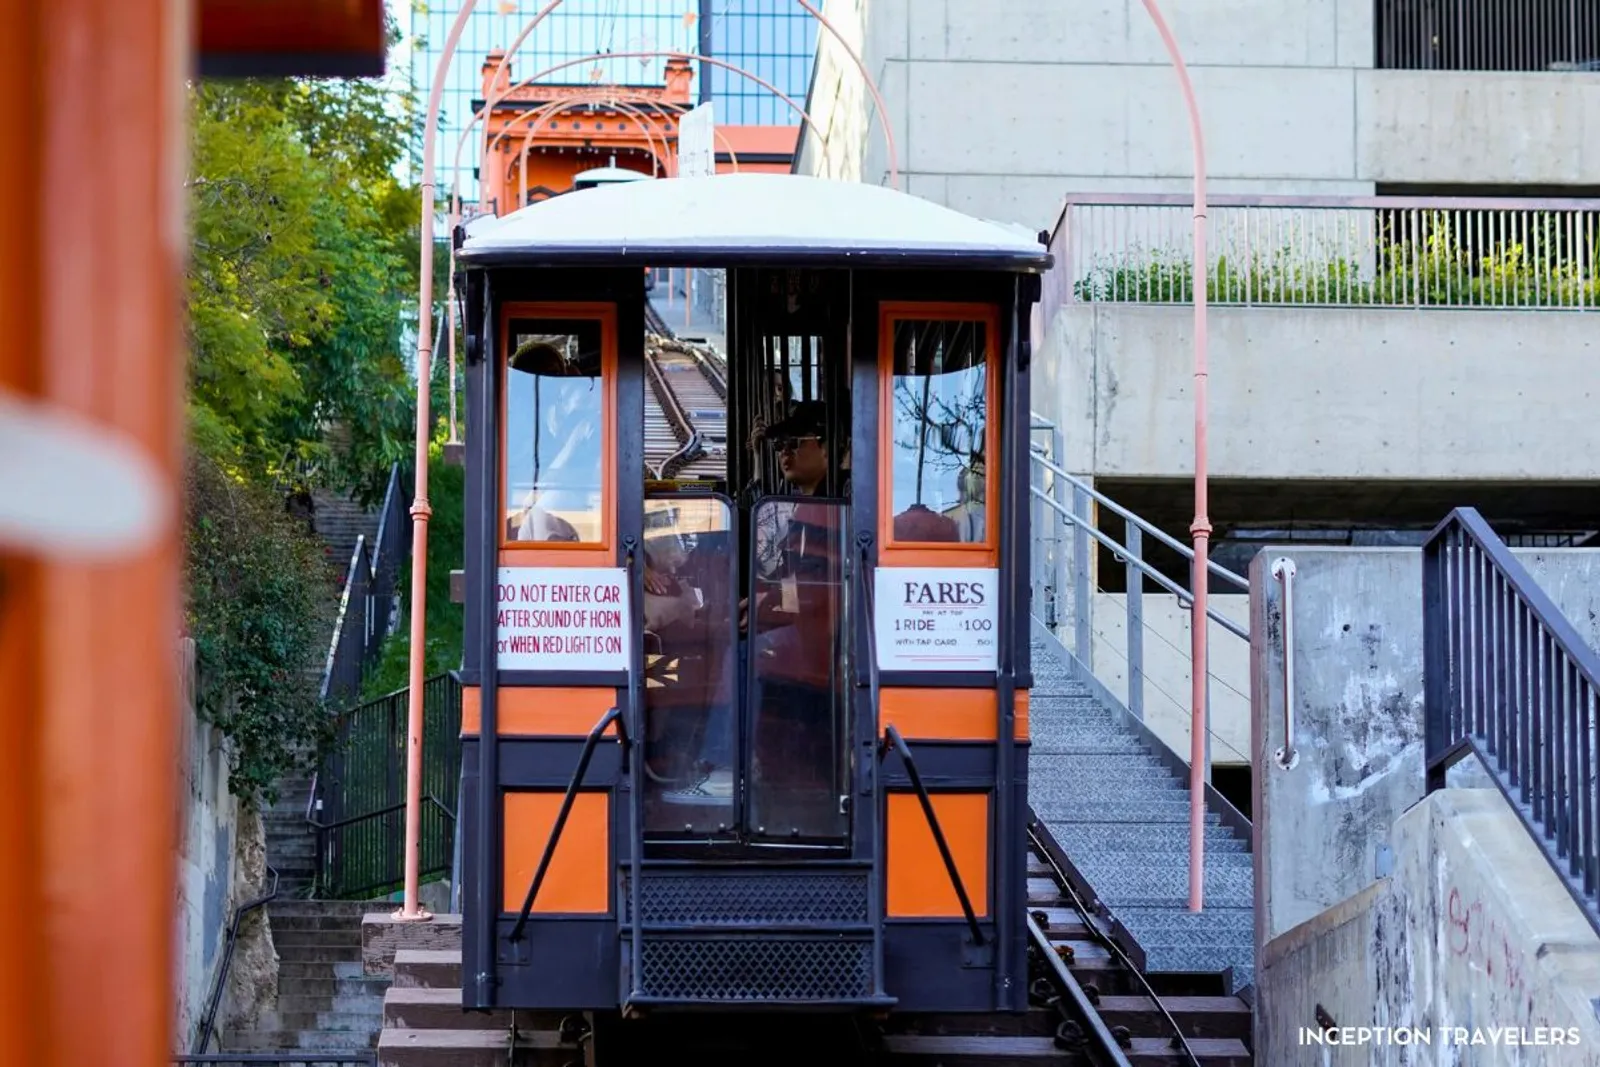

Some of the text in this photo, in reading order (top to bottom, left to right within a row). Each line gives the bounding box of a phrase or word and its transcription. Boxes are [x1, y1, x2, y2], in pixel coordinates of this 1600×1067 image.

[496, 584, 620, 603] DO NOT ENTER CAR
[904, 582, 985, 604] FARES
[497, 609, 621, 628] AFTER SOUND OF HORN
[895, 619, 900, 631] 1
[903, 619, 935, 631] RIDE
[496, 635, 621, 653] or WHEN RED LIGHT IS ON
